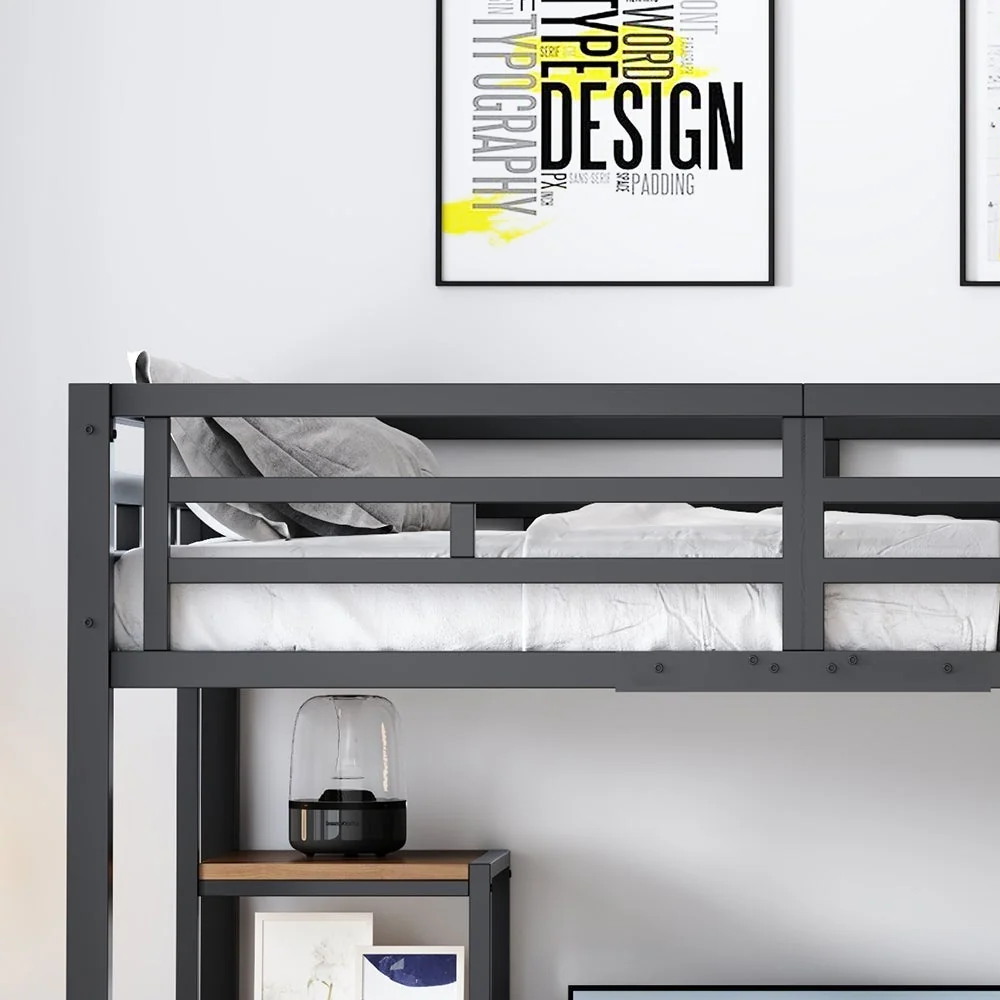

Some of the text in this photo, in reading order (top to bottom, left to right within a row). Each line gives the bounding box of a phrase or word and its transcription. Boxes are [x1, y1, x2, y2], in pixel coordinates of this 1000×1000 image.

[622, 5, 674, 79] WORD
[472, 14, 537, 216] TYPOGRAPHY
[541, 81, 743, 171] DESIGN
[541, 173, 567, 189] PX
[632, 173, 695, 195] PADDING
